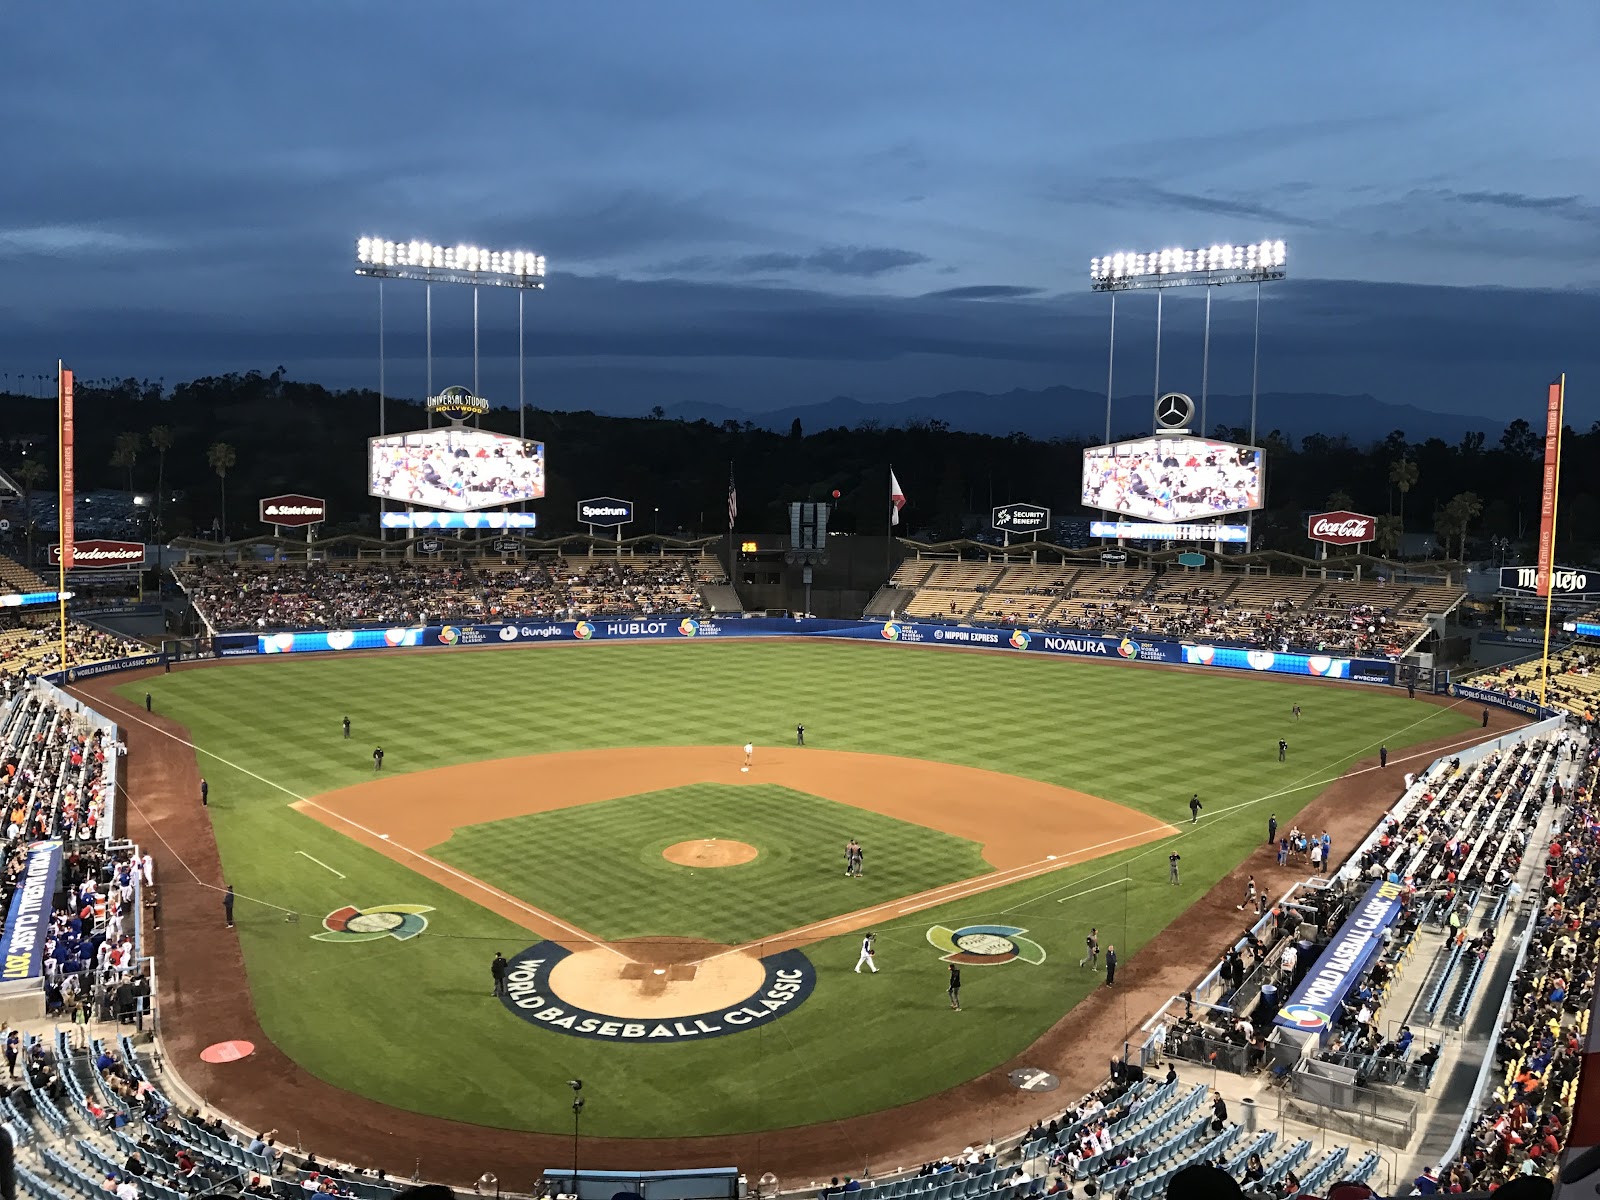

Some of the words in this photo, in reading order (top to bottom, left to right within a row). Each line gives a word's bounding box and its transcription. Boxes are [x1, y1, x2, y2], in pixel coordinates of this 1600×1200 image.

[427, 395, 463, 407] UNIVERSAL
[465, 395, 490, 410] STUDIOS
[436, 405, 483, 414] HOLLYWOOD
[1548, 401, 1558, 437] Emirates
[1547, 436, 1555, 450] Fly
[1544, 466, 1554, 501] Emirates
[582, 506, 627, 518] Spectrum
[1543, 500, 1551, 514] Fly
[64, 507, 72, 539] Emirates
[1313, 519, 1369, 537] Coca-Cola
[1540, 531, 1549, 565] Emirates
[1517, 568, 1586, 592] Mtejo
[521, 626, 561, 638] GungHo
[607, 622, 667, 635] HUBLOT
[944, 630, 969, 641] NIPPON
[970, 632, 999, 643] EXPRESS
[1045, 638, 1106, 653] NOMURA
[77, 668, 95, 677] WORLD
[95, 663, 121, 674] BASEBALL
[121, 660, 145, 670] CLASSIC
[145, 657, 160, 665] 2017
[1459, 689, 1479, 699] WORLD
[1480, 694, 1506, 705] BASEBALL
[1506, 700, 1526, 712] CLASSIC
[1526, 706, 1537, 715] 2017
[28, 851, 51, 877] WORLD
[18, 876, 47, 915] BASEBALL
[9, 914, 40, 953] CLASSIC
[1300, 970, 1345, 1006] WORLD
[1325, 930, 1373, 973] BASEBALL
[1355, 898, 1393, 930] CLASSIC
[1376, 881, 1403, 900] 2017
[3, 952, 32, 978] 2017
[507, 958, 546, 1009] WORLD
[533, 1006, 722, 1039] BASEBALL
[724, 968, 803, 1025] CLASSIC
